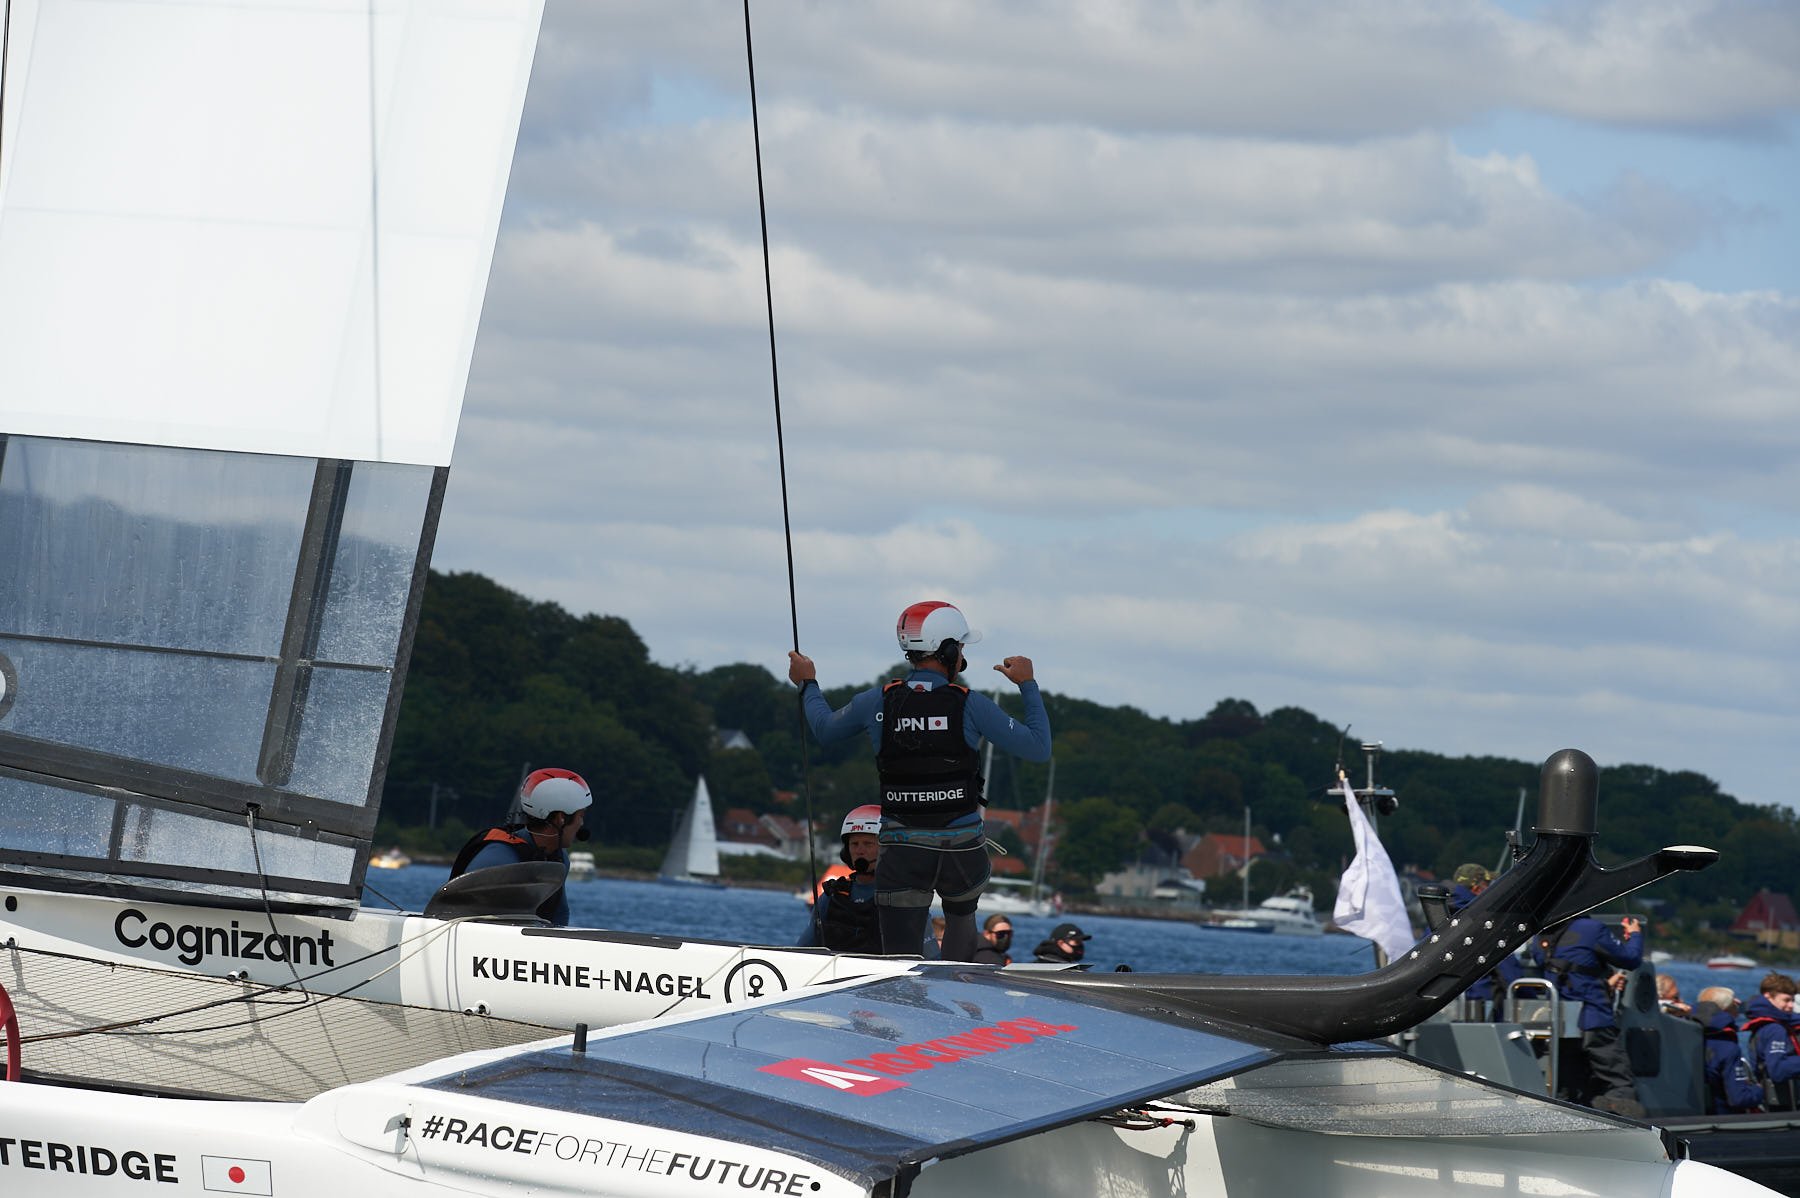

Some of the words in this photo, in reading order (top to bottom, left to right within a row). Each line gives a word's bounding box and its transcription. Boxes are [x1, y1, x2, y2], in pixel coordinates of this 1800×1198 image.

[894, 717, 925, 732] JPN
[886, 788, 965, 802] OUTTERIDGE
[114, 908, 334, 967] Cognizant
[472, 956, 711, 1000] KUEHNE+NAGEL
[421, 1115, 811, 1197] #RACEFORTHEFUTURE
